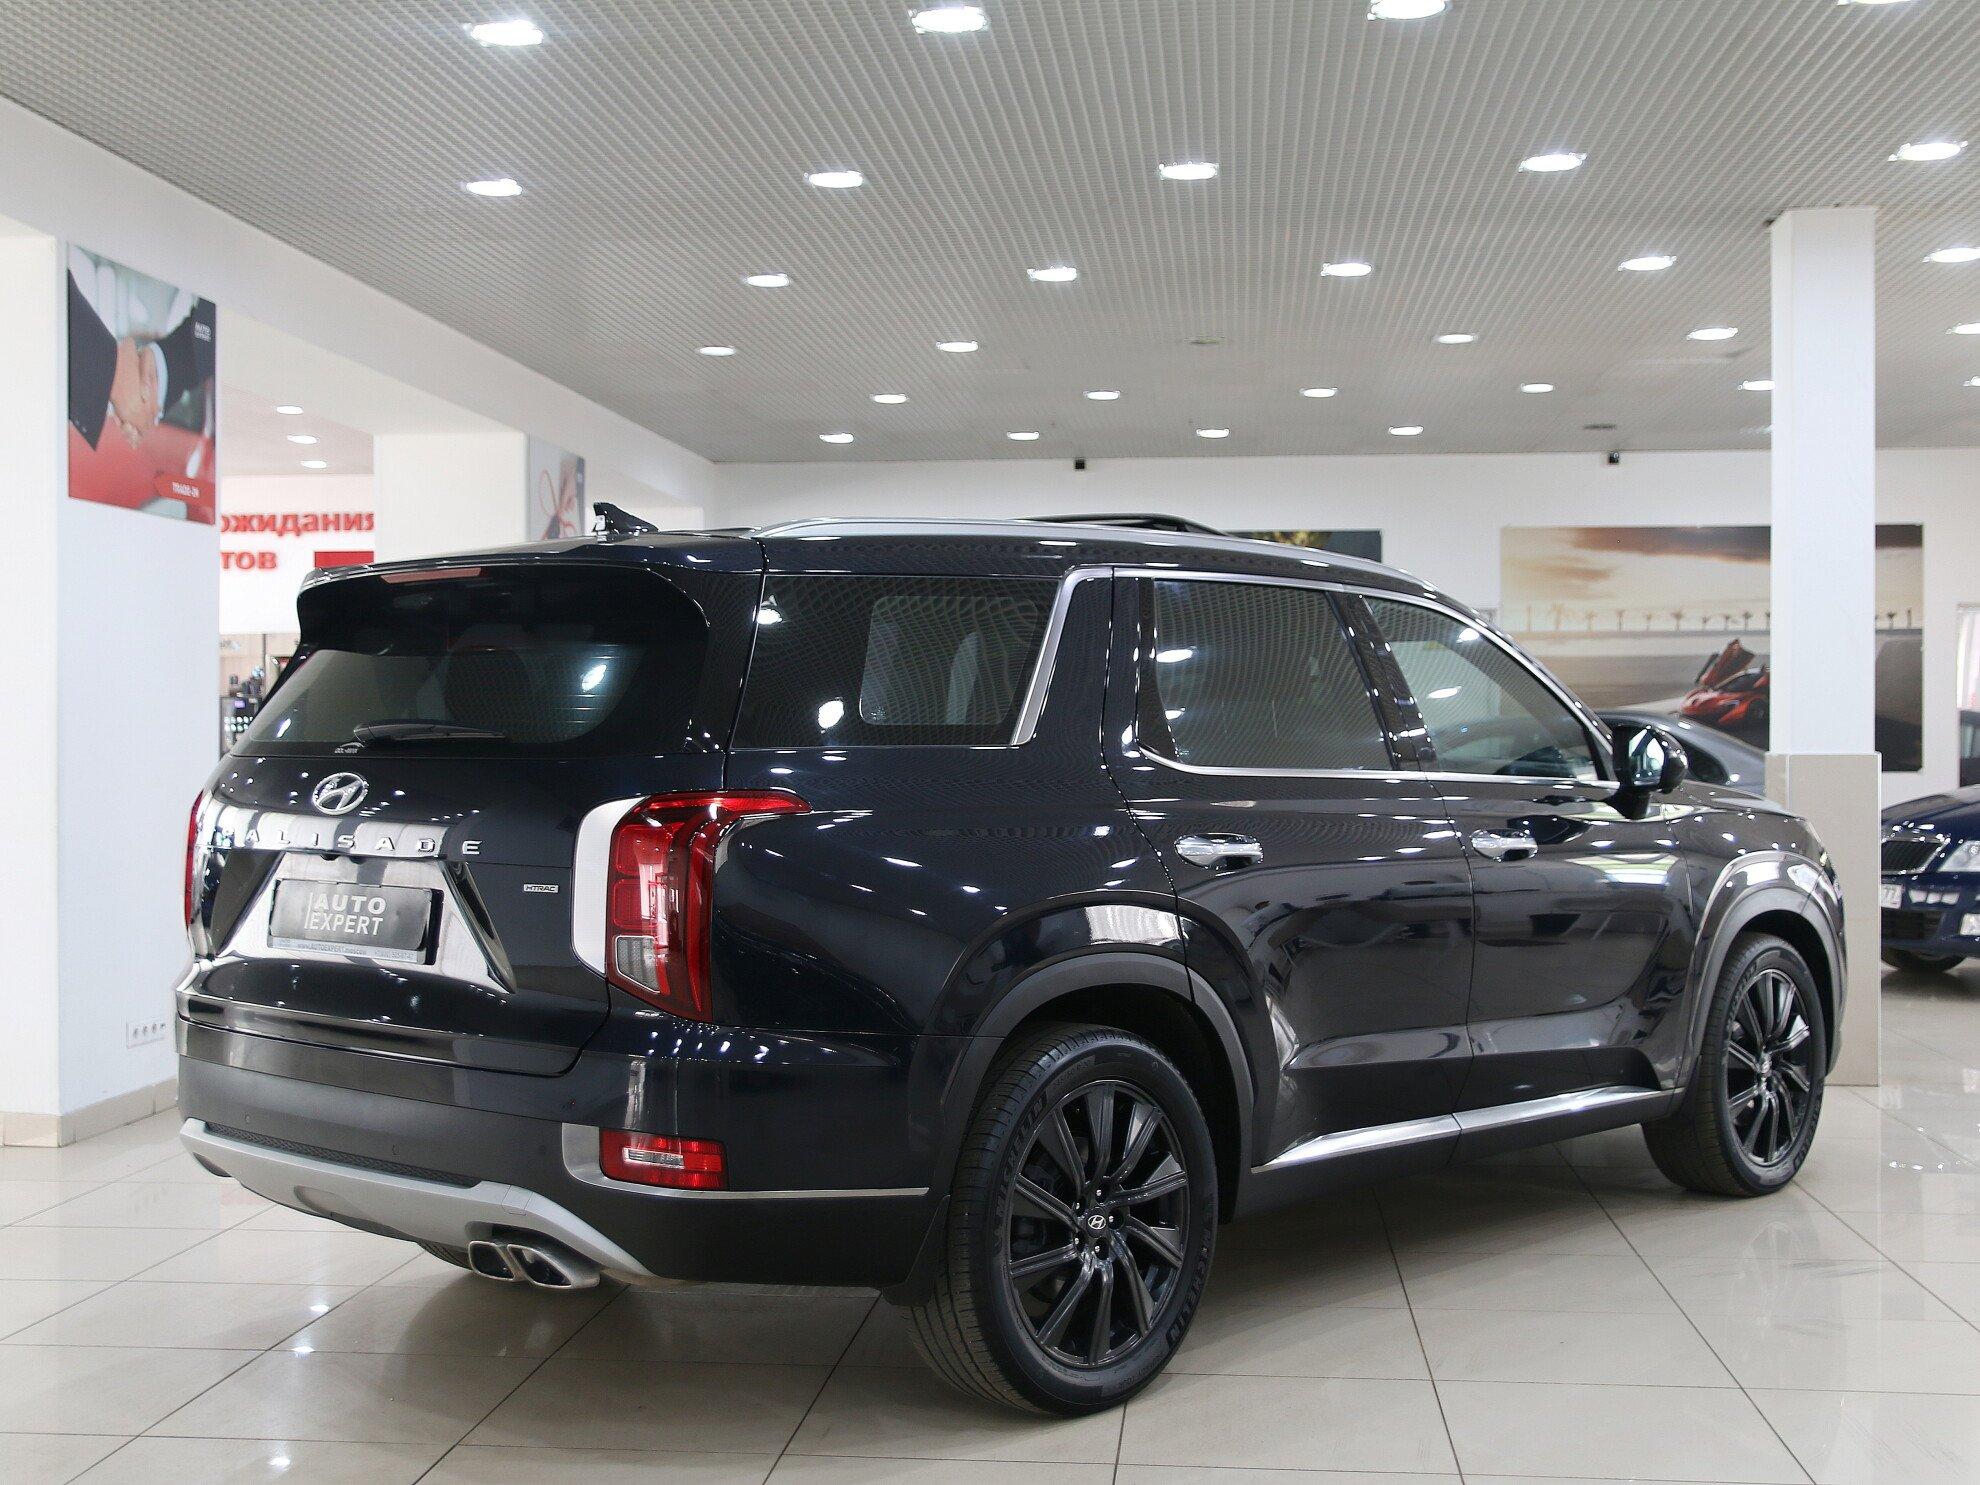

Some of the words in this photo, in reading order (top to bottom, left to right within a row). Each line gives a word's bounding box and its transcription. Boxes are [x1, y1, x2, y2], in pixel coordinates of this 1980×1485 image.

[524, 884, 557, 893] HTRAC
[313, 893, 387, 915] AUTO
[310, 912, 384, 936] EXPERT
